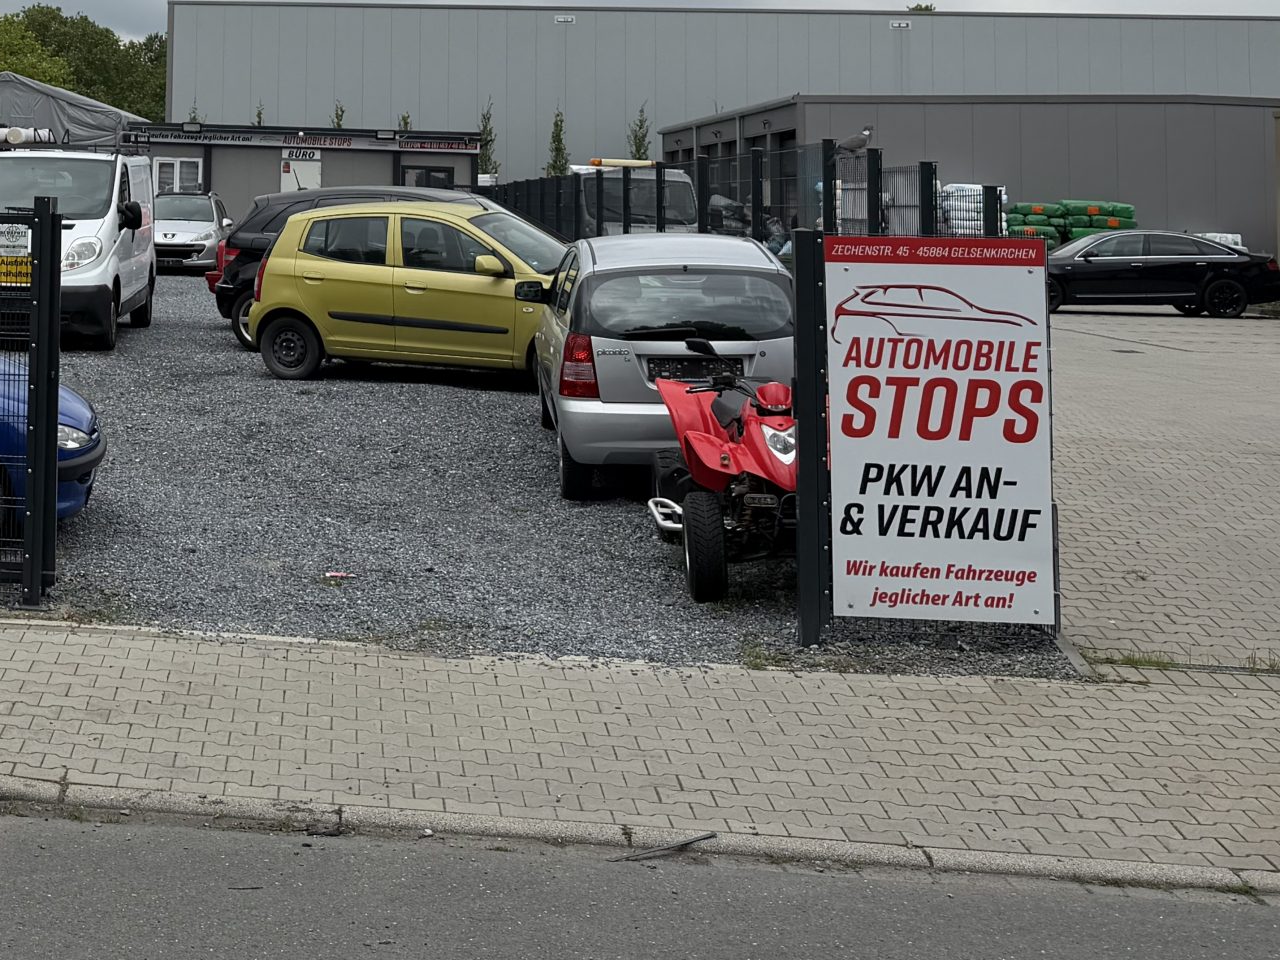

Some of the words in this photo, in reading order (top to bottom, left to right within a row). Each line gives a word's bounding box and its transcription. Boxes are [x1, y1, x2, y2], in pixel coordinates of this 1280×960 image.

[282, 135, 327, 146] AUTOMOBILE
[328, 137, 352, 147] STOPS
[288, 148, 315, 159] BÜRO
[832, 244, 894, 257] ZECHENSTR.
[896, 246, 909, 257] 45
[916, 246, 949, 258] 45884
[951, 247, 1036, 259] GELSENKIRCHEN
[842, 336, 1042, 373] AUTOMOBILE
[841, 375, 1044, 444] STOPS
[859, 462, 946, 498] PKW
[949, 466, 1018, 500] AN-
[839, 502, 865, 536] &
[877, 503, 1042, 542] VERKAUF
[846, 559, 876, 577] Wir
[878, 561, 941, 579] kaufen
[945, 563, 1038, 587] Fahrzeuge
[870, 587, 949, 609] jeglicher
[951, 590, 981, 608] Art
[984, 592, 1015, 609] an!
